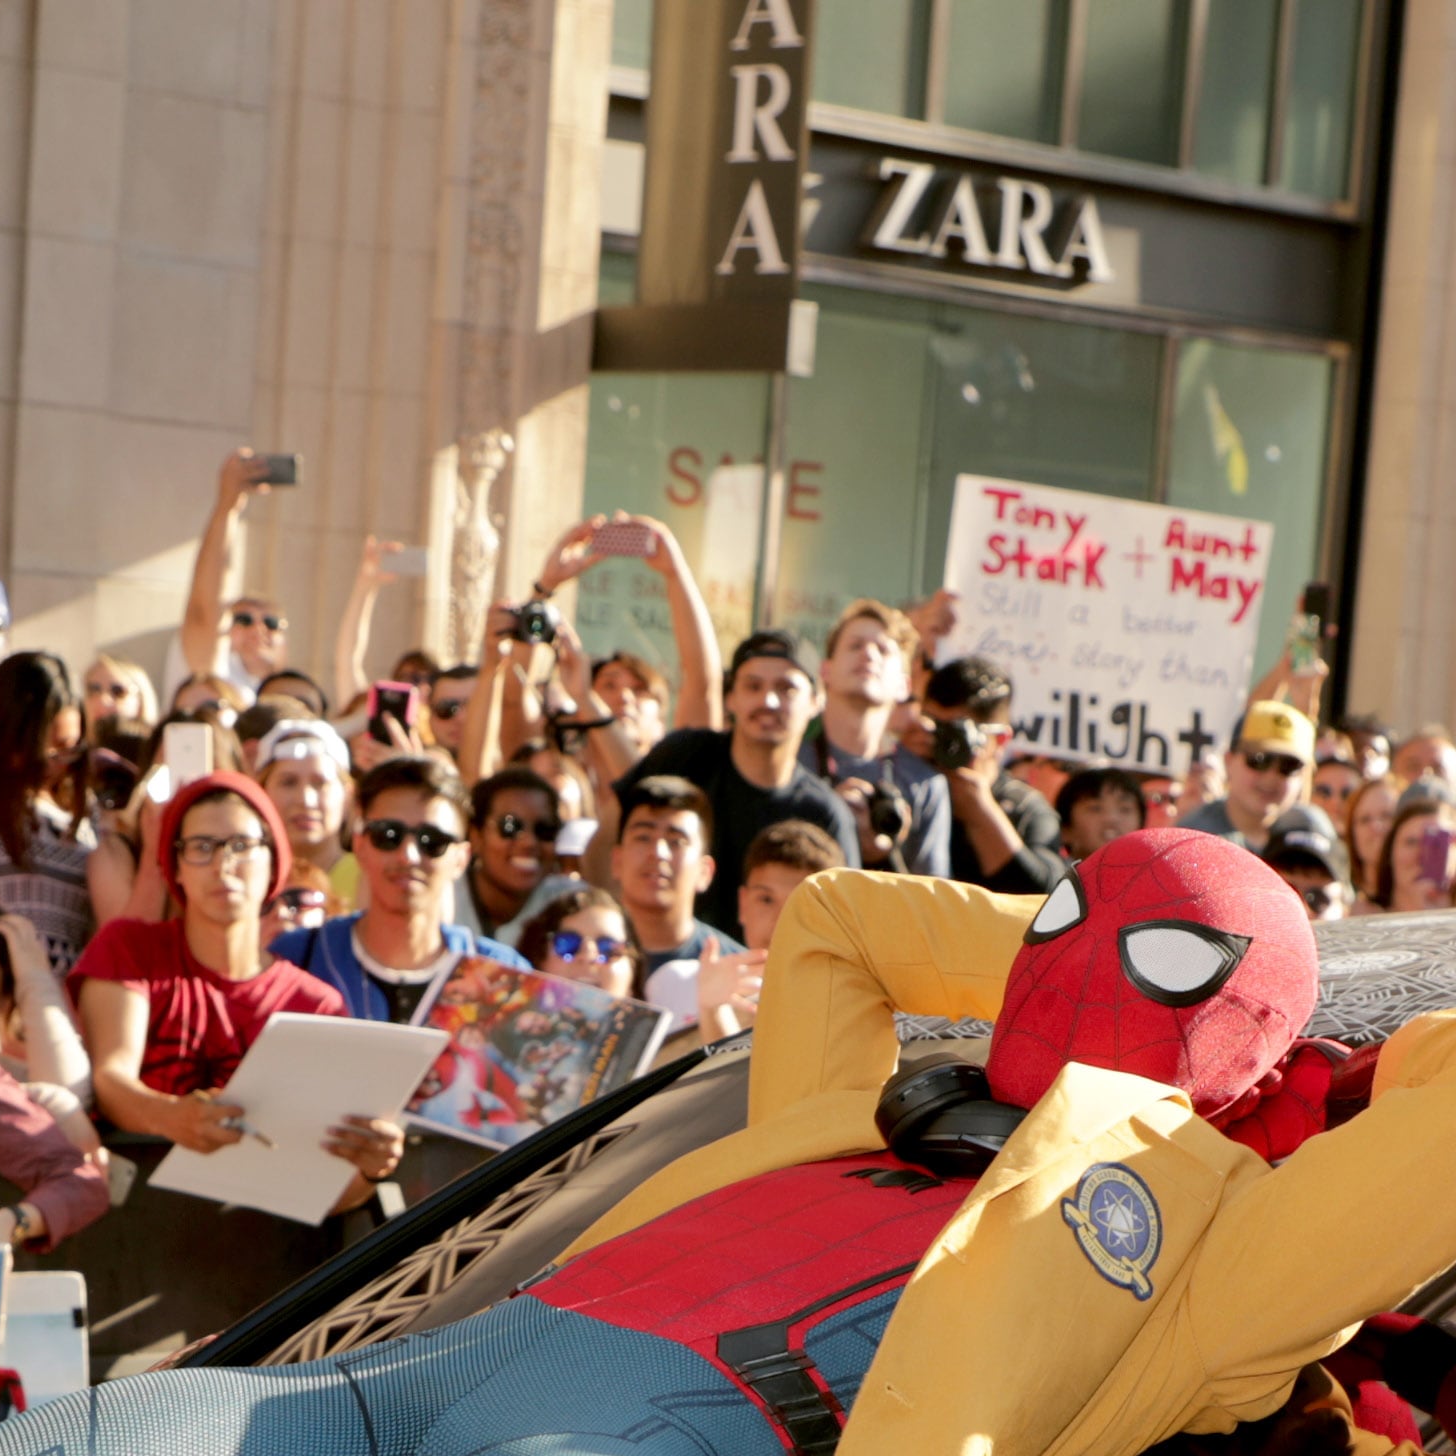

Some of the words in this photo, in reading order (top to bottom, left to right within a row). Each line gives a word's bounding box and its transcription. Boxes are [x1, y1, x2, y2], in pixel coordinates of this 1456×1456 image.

[873, 156, 1115, 284] ZARA
[665, 447, 824, 520] SE
[983, 488, 1087, 551] Tony
[1164, 519, 1260, 563] Aunt
[1168, 558, 1263, 625] May
[1010, 690, 1215, 768] wilight
